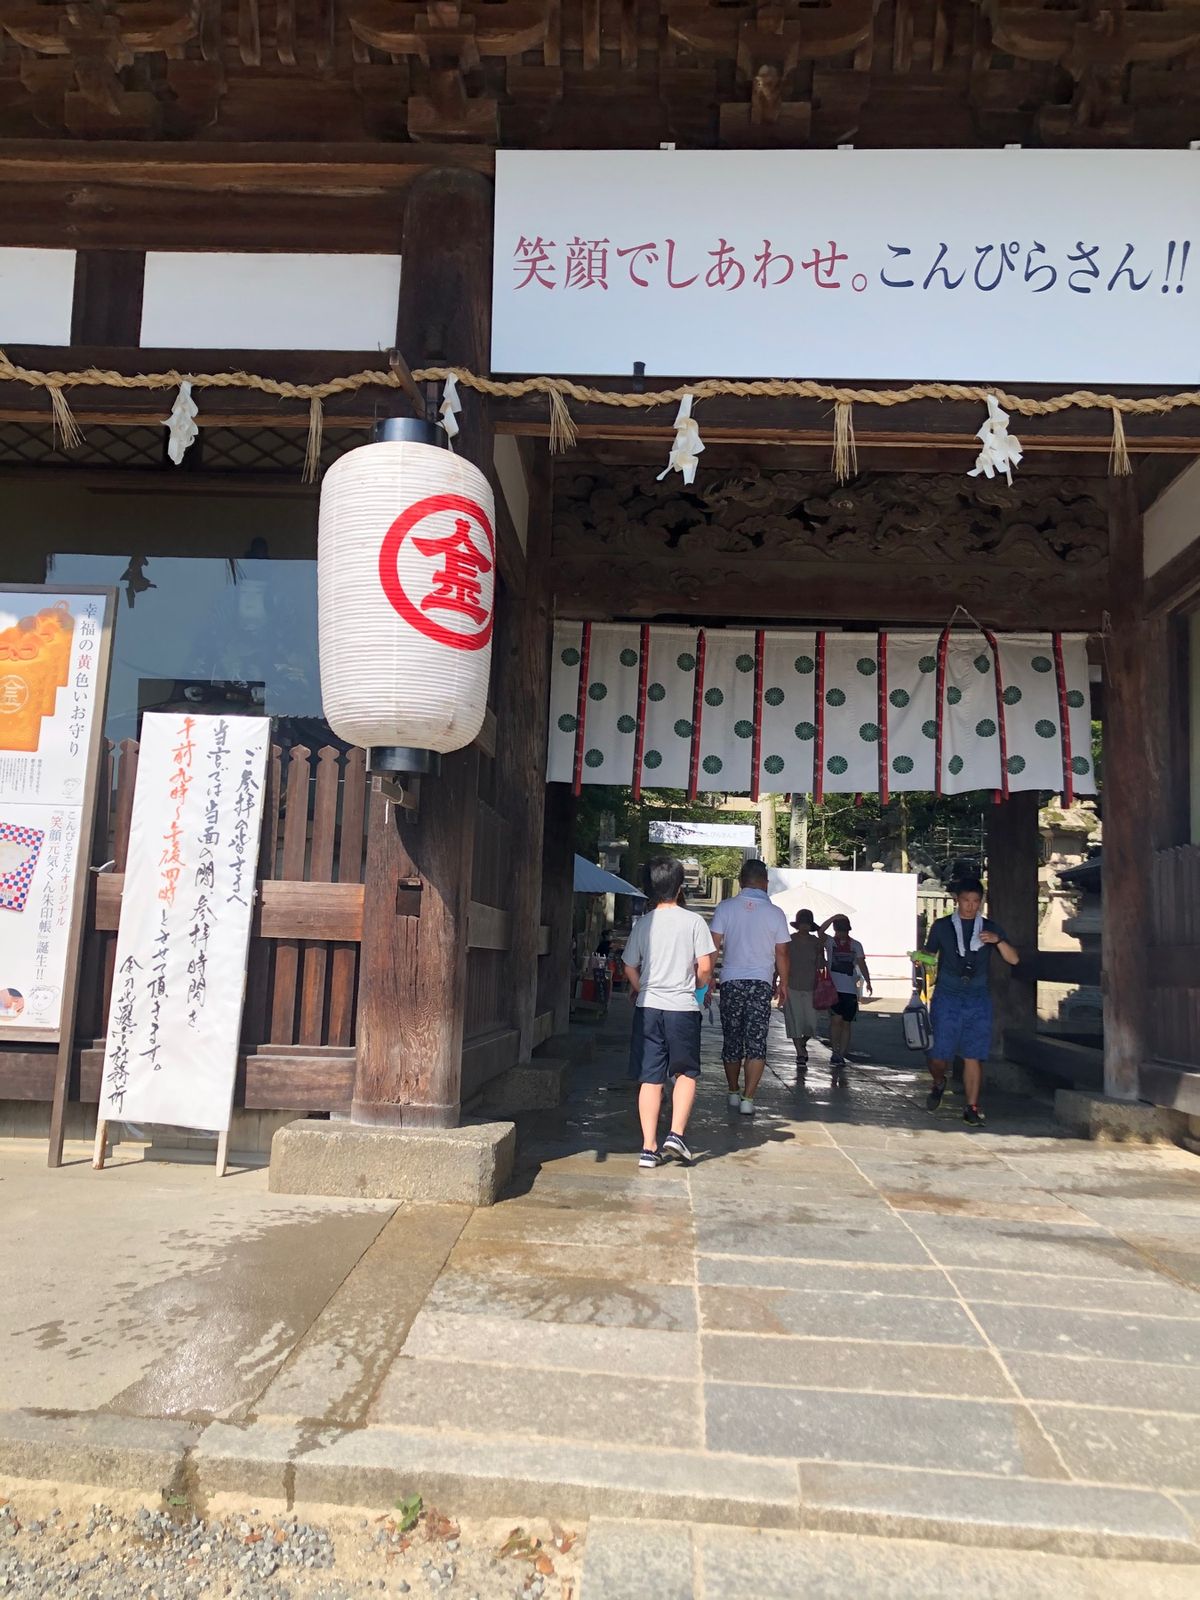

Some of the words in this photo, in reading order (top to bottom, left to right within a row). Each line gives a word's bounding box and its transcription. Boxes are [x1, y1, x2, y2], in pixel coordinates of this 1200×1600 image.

[69, 602, 98, 758] 幸福の黄色いお守り
[107, 955, 144, 1114] 金刀比羅宮社務所
